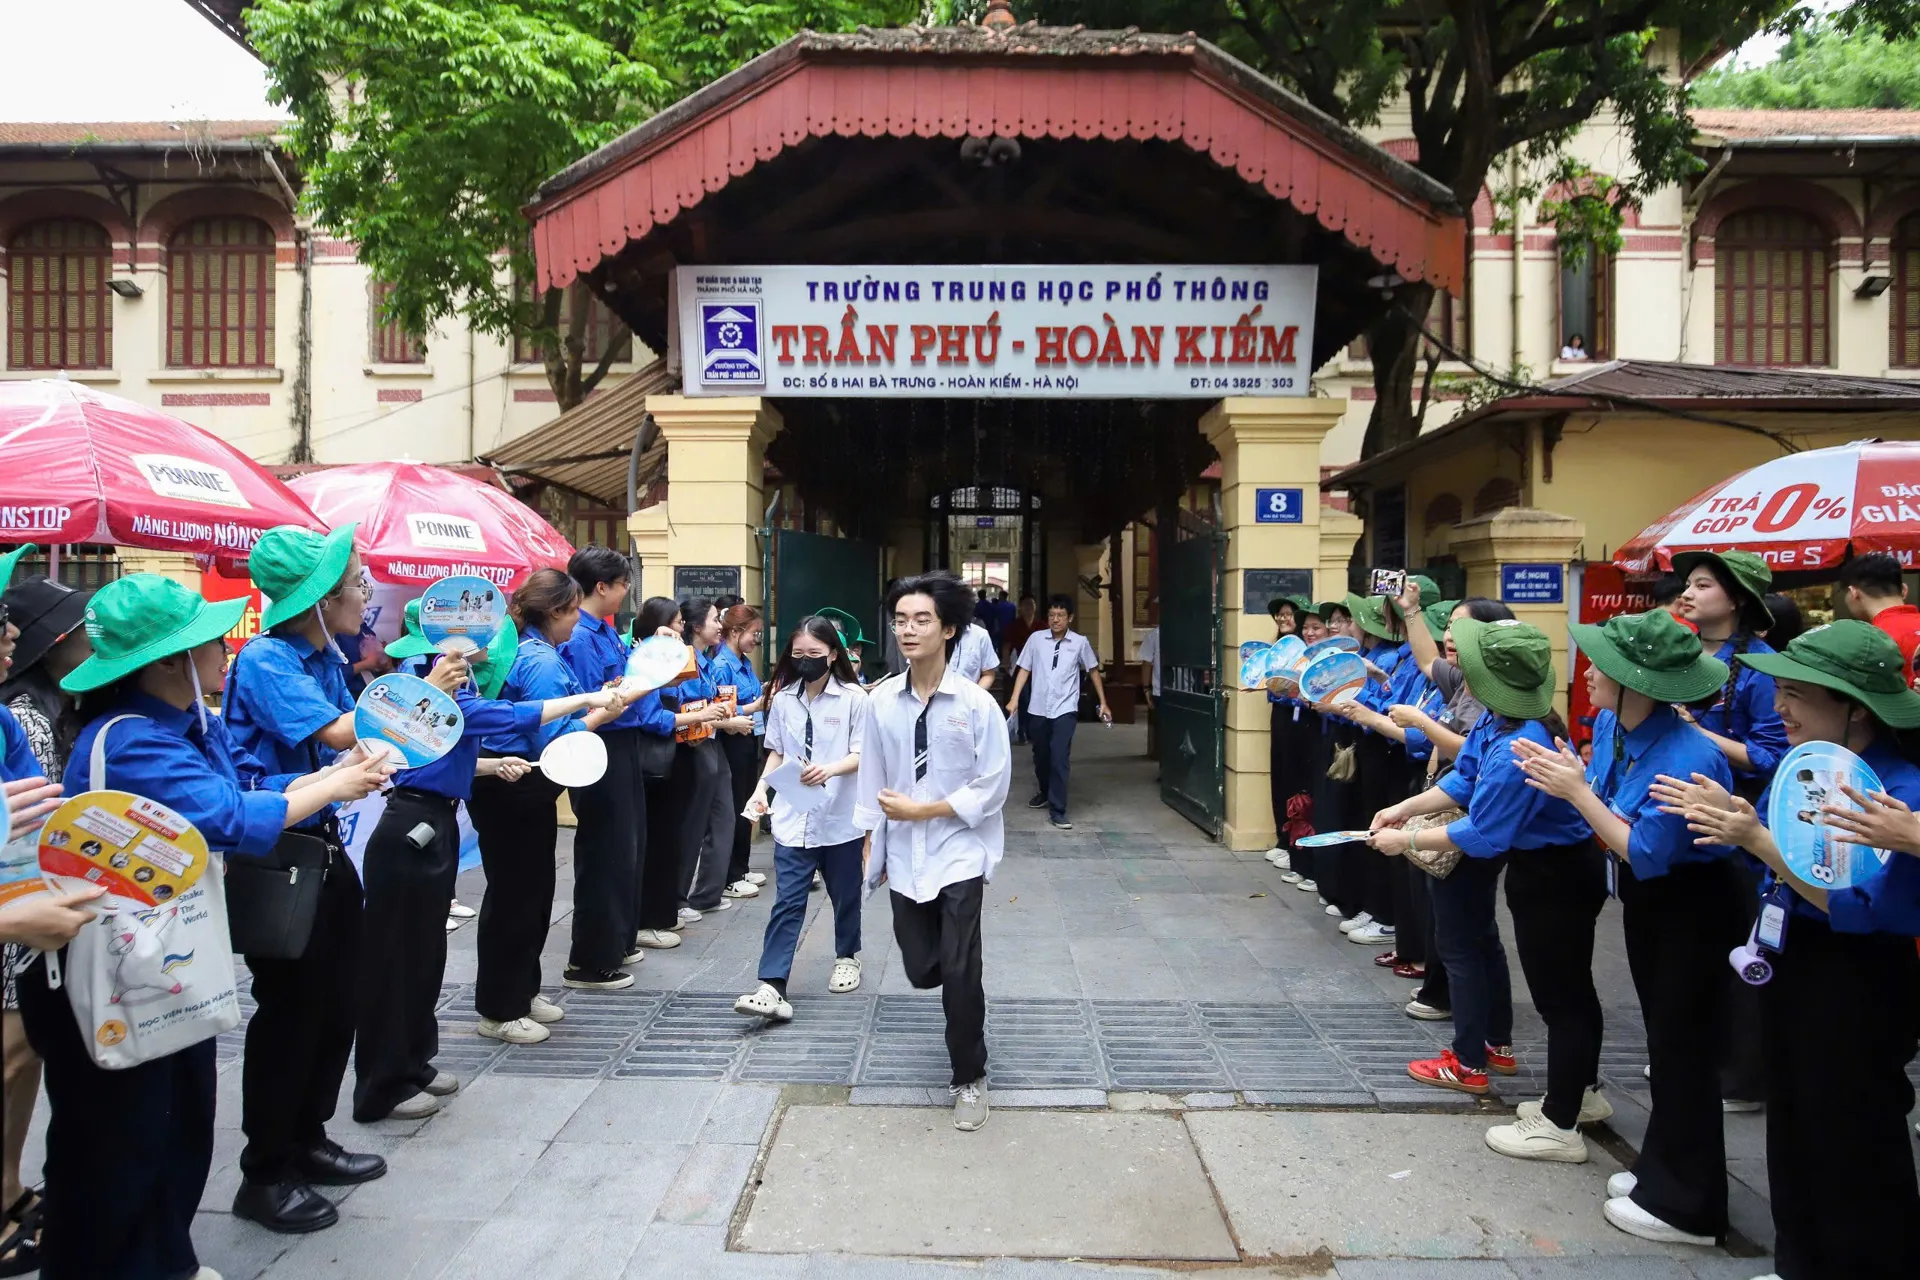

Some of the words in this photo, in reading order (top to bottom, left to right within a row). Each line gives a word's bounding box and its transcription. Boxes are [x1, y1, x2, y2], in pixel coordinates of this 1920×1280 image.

[697, 286, 719, 294] THÀNH
[721, 285, 736, 294] PHỐ
[738, 285, 747, 294] HÀ
[749, 284, 762, 294] NỘI
[806, 275, 920, 302] TRƯỜNG
[932, 281, 1026, 302] TRUNG
[1038, 281, 1094, 306] HỌC
[1106, 272, 1162, 301] PHỔ
[1174, 276, 1270, 301] THÔNG
[772, 304, 899, 365] TRẦN
[910, 310, 1002, 365] PHÚ
[1012, 340, 1024, 349] -
[1035, 312, 1164, 364] HOÀN
[1174, 304, 1299, 364] KIẾM
[783, 377, 805, 388] ĐC:
[810, 372, 827, 388] SỐ
[832, 377, 838, 388] 8
[842, 377, 864, 388] HAI
[869, 374, 887, 388] BÀ
[892, 376, 936, 388] TRƯNG
[948, 374, 986, 388] HOÀN
[990, 372, 1021, 388] KIẾM
[1033, 375, 1052, 388] HÀ
[1056, 376, 1078, 390] NỘI
[1190, 378, 1211, 388] ĐT:
[1214, 378, 1228, 388] 04
[1232, 378, 1261, 388] 3825
[1270, 492, 1287, 512] 8
[1708, 491, 1762, 513] TRẢ
[1861, 499, 1920, 523] GIẢ
[132, 514, 170, 536] NĂNG
[172, 521, 212, 542] LƯỢNG
[214, 522, 266, 549] NÖNS
[1692, 513, 1749, 534] GÓP
[388, 560, 415, 576] NĂNG
[418, 564, 450, 579] LƯỢNG
[178, 889, 204, 904] Shake
[180, 904, 196, 914] The
[182, 910, 208, 925] World
[138, 1016, 160, 1029] HỌC
